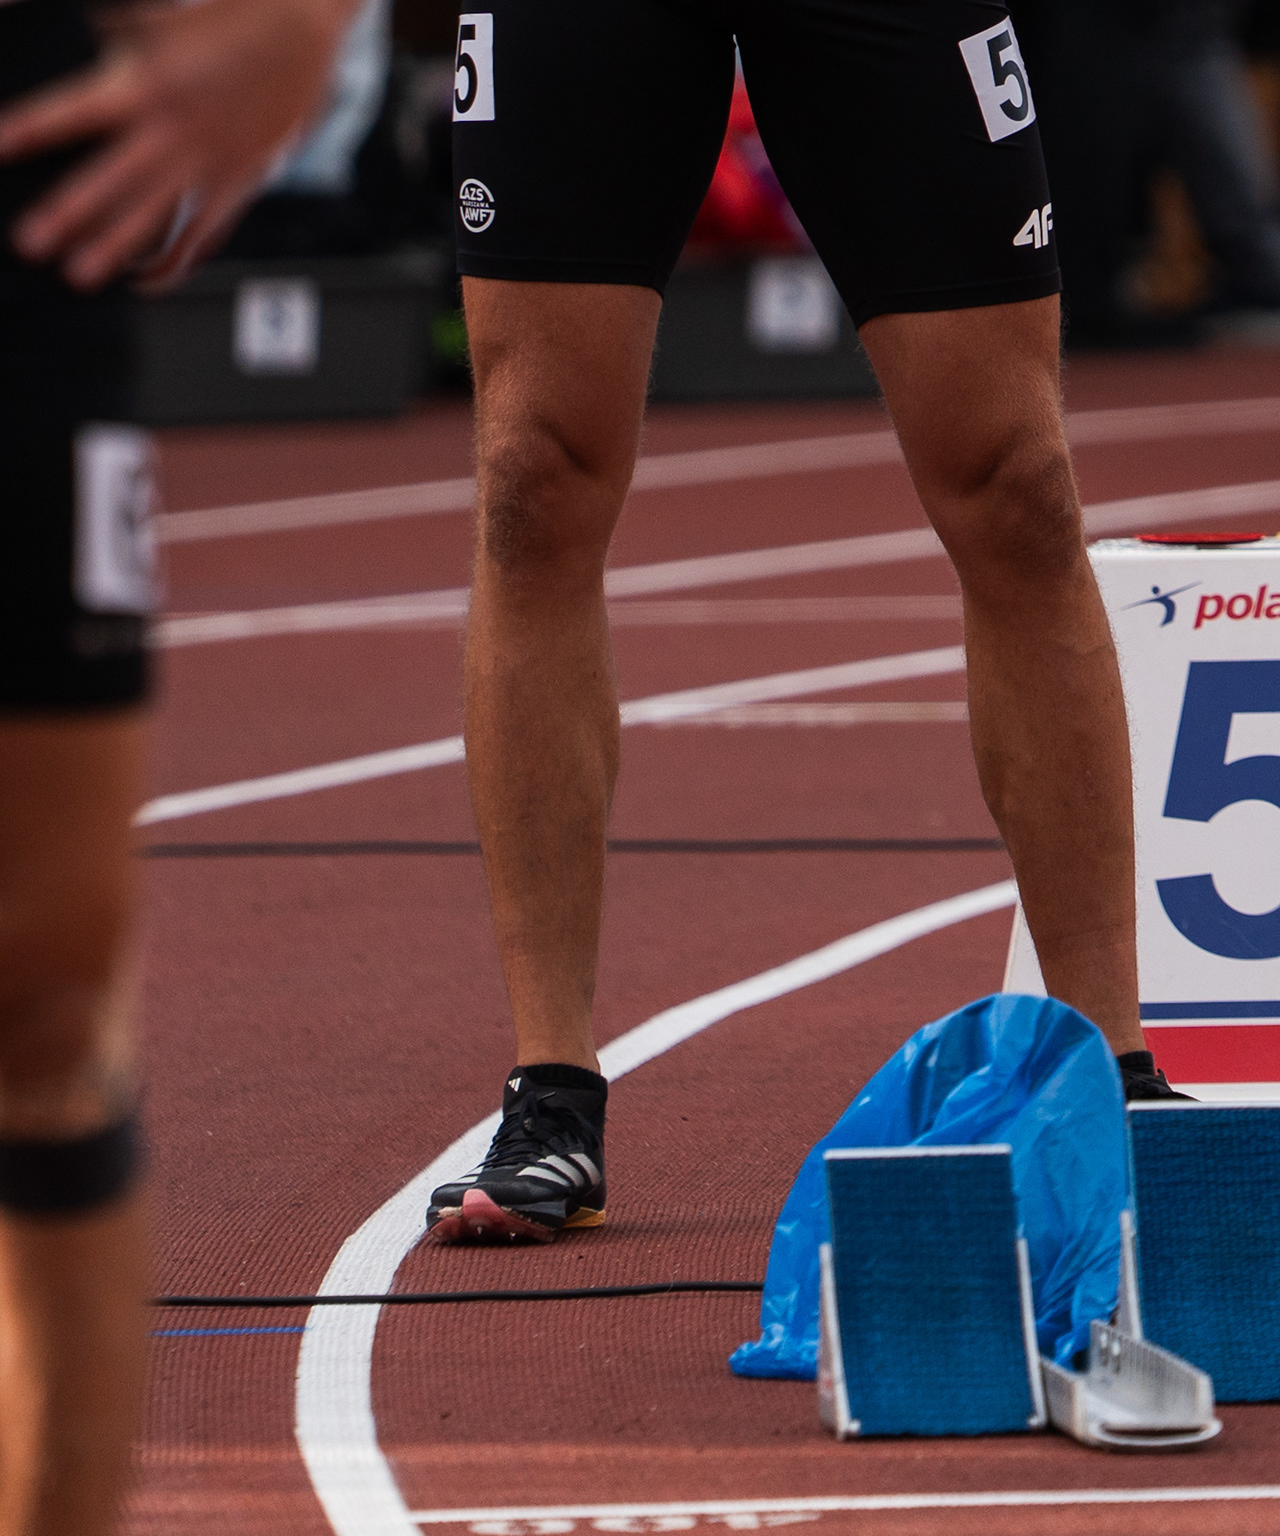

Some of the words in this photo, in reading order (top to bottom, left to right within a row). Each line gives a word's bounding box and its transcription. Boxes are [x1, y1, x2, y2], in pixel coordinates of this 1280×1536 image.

[454, 24, 478, 114] 5
[986, 29, 1030, 122] 5
[464, 207, 488, 222] AWF
[465, 187, 484, 202] AZS
